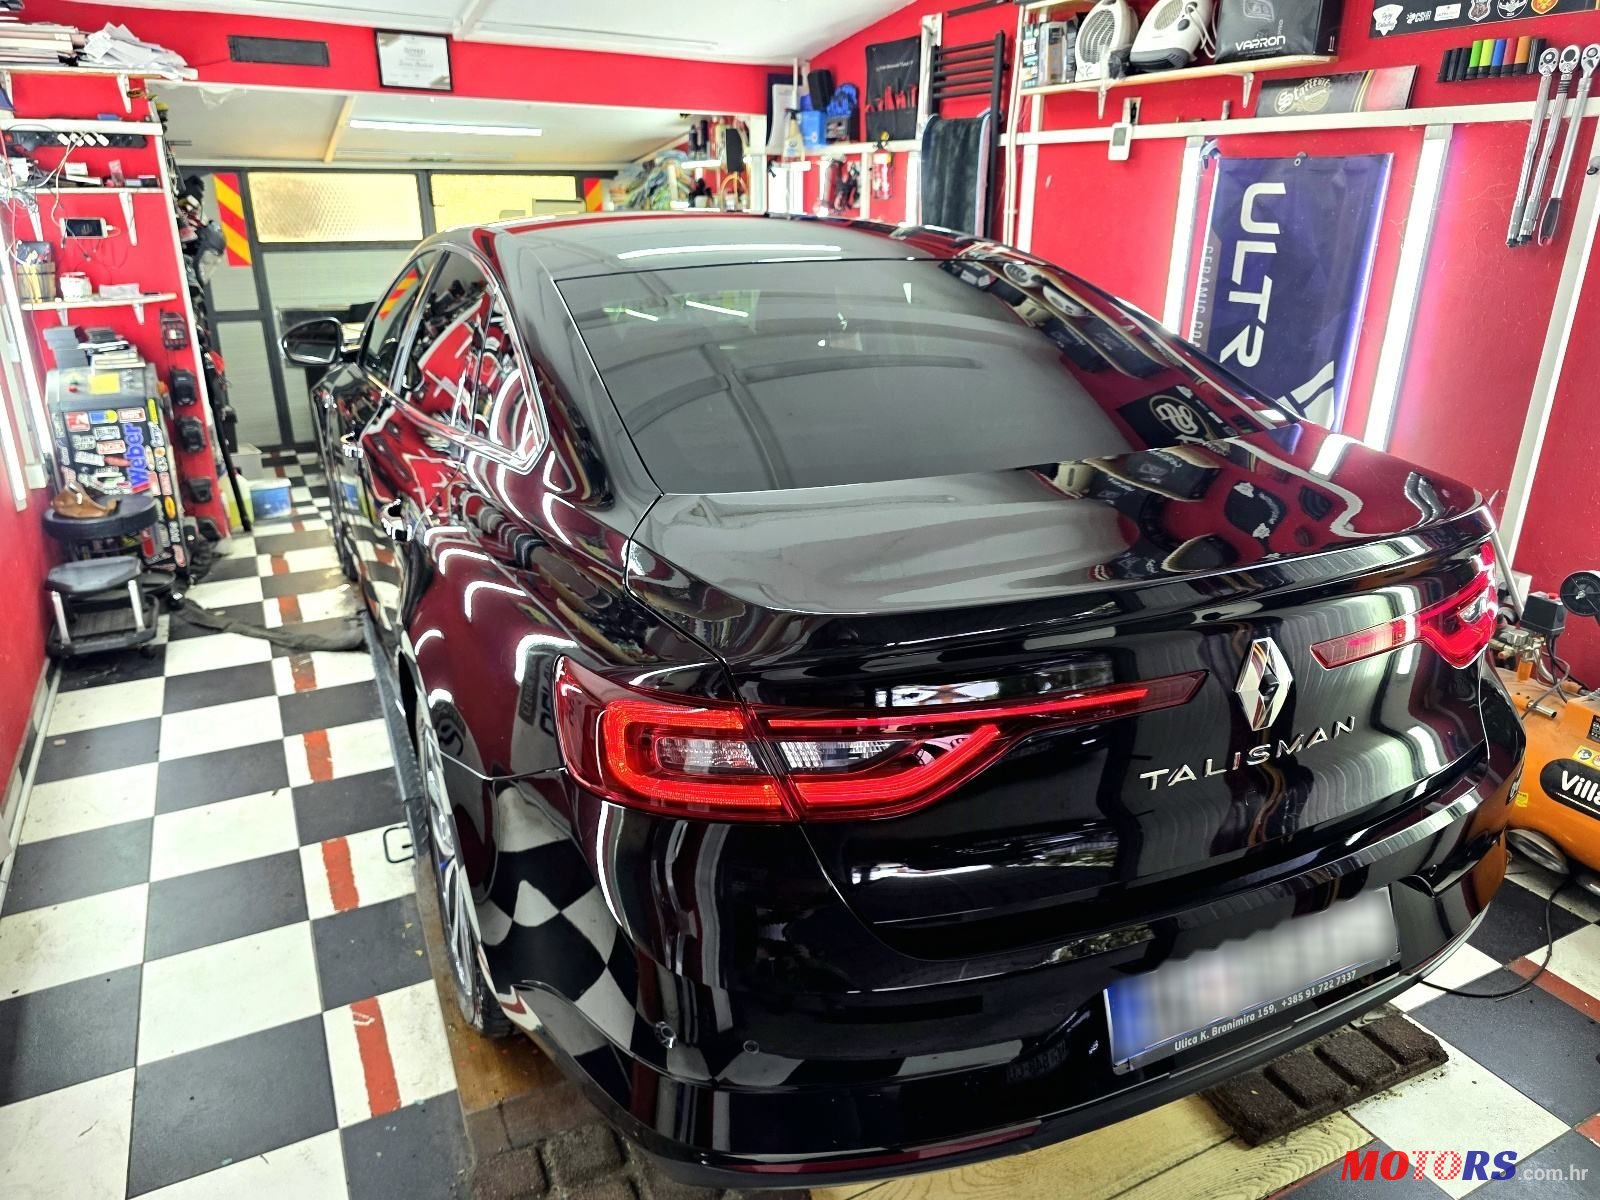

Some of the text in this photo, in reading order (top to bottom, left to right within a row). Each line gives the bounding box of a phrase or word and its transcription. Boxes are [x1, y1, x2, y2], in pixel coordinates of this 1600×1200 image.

[1139, 716, 1356, 791] TALISMAN
[1174, 1035, 1198, 1052] Ulica
[1200, 1030, 1210, 1041] K.
[1281, 992, 1304, 1007] +385
[1305, 987, 1316, 998] 91
[1318, 980, 1335, 993] 722
[1336, 970, 1357, 986] 7337
